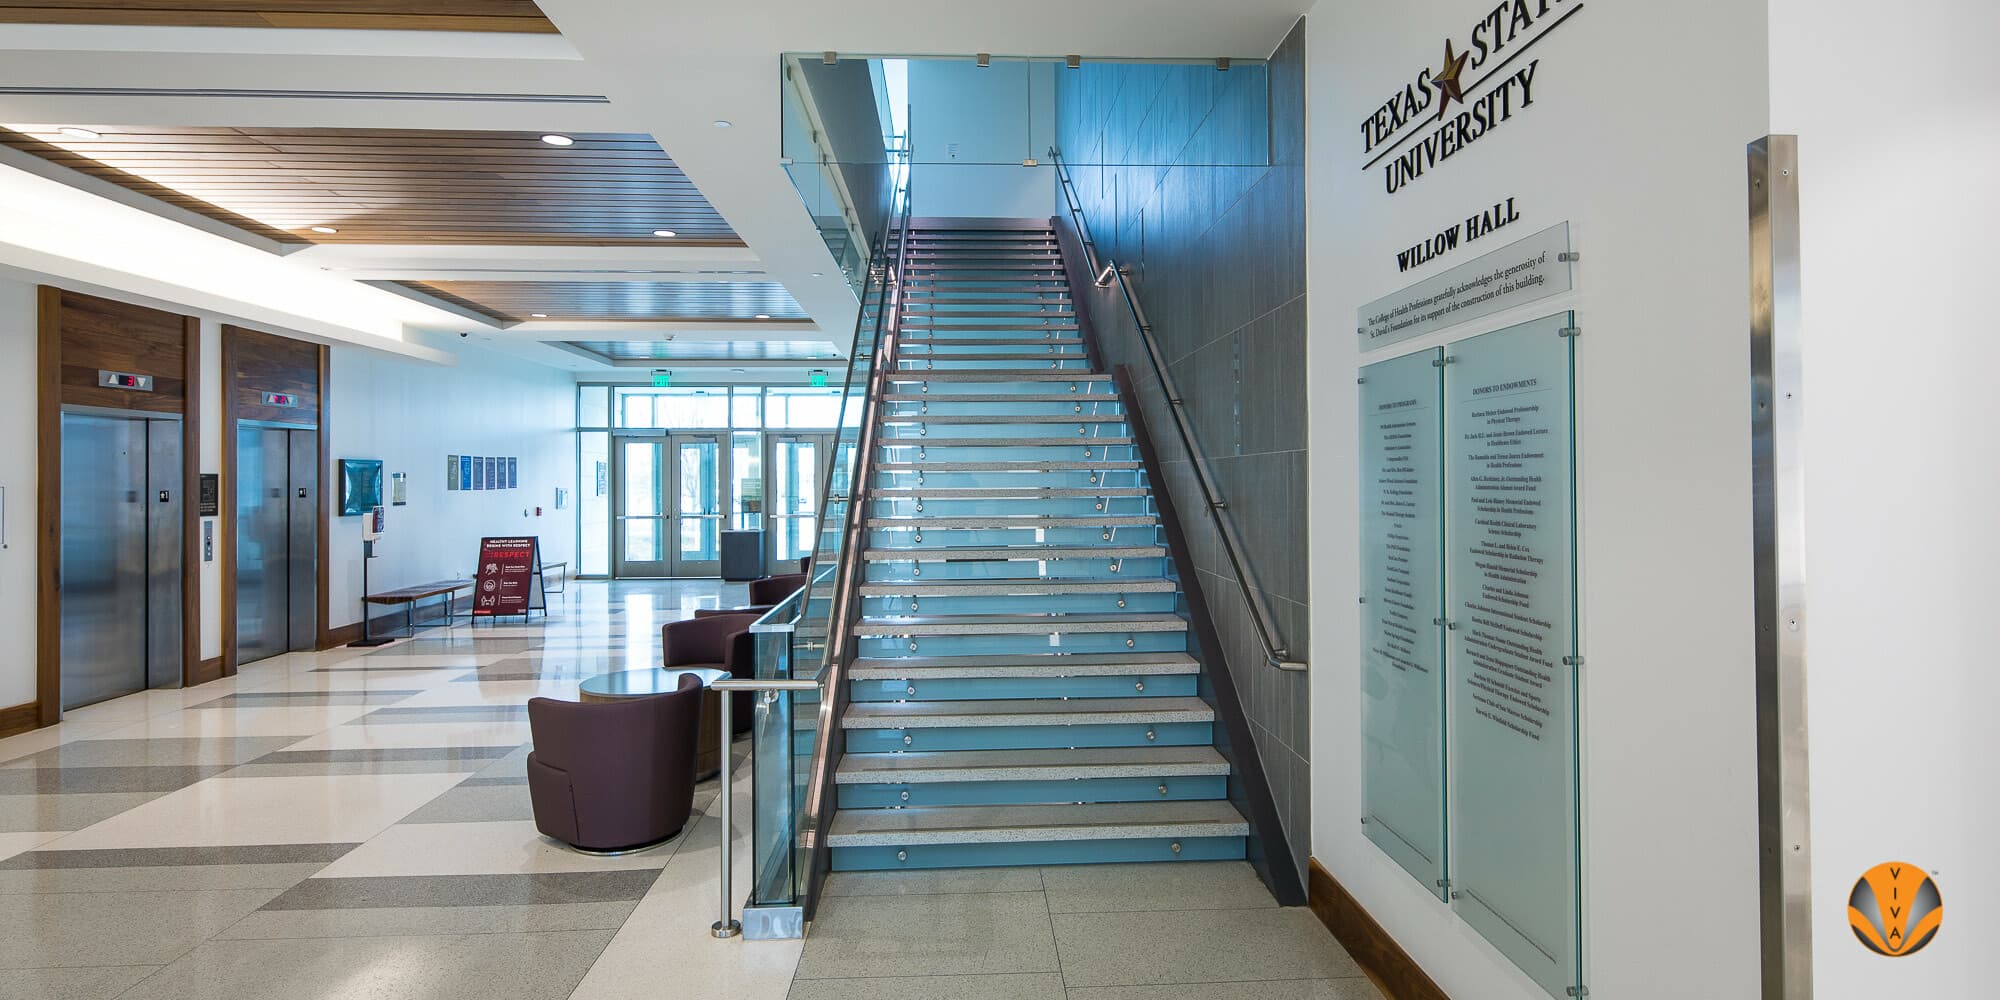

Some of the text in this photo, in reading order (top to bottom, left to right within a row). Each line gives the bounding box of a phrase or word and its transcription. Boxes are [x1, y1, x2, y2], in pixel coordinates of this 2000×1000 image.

[1361, 0, 1563, 154] TEXAS STA
[1384, 59, 1539, 194] UNIVERSITY
[1396, 197, 1520, 273] WILLOW HALL
[1409, 297, 1433, 312] Professions
[1433, 286, 1456, 306] gratefully
[1456, 274, 1493, 294] acknowledges
[1494, 268, 1504, 281] the
[1504, 257, 1537, 280] generosity
[1537, 250, 1546, 265] of
[1427, 308, 1445, 322] support
[1445, 302, 1452, 314] of
[1452, 301, 1460, 312] the
[1461, 290, 1495, 308] construction
[1495, 284, 1503, 297] of
[1503, 281, 1514, 295] this
[1515, 273, 1545, 291] building.
